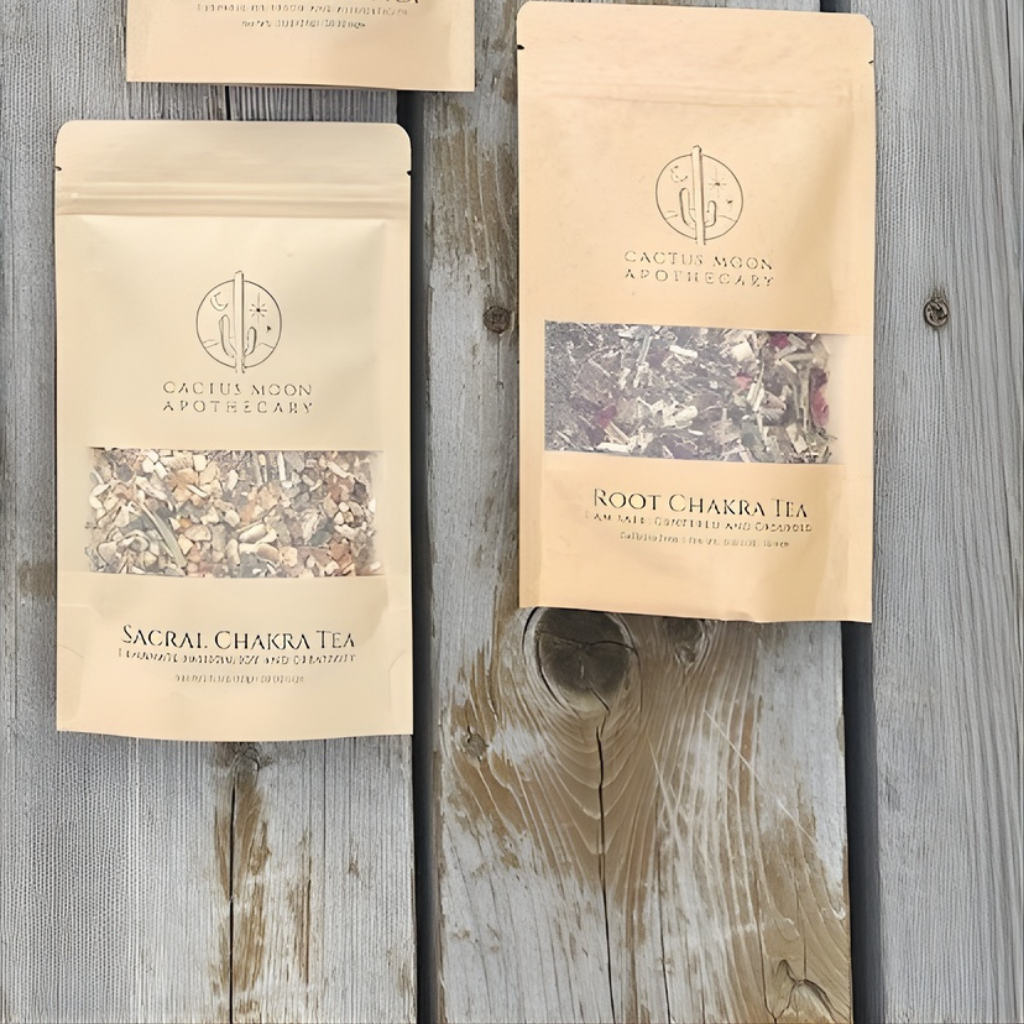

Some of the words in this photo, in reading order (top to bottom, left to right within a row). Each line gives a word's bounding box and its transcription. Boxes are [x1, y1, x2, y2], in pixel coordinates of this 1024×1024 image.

[625, 250, 703, 266] CACTUS
[713, 256, 772, 270] MOON
[163, 381, 241, 395] CACTUS
[251, 384, 312, 396] MOON
[594, 489, 662, 510] ROOT
[669, 494, 765, 516] CHAKRA
[772, 498, 807, 518] TEA
[122, 625, 208, 649] SACRAL
[215, 631, 310, 650] CHAKRA
[316, 630, 354, 649] TEA
